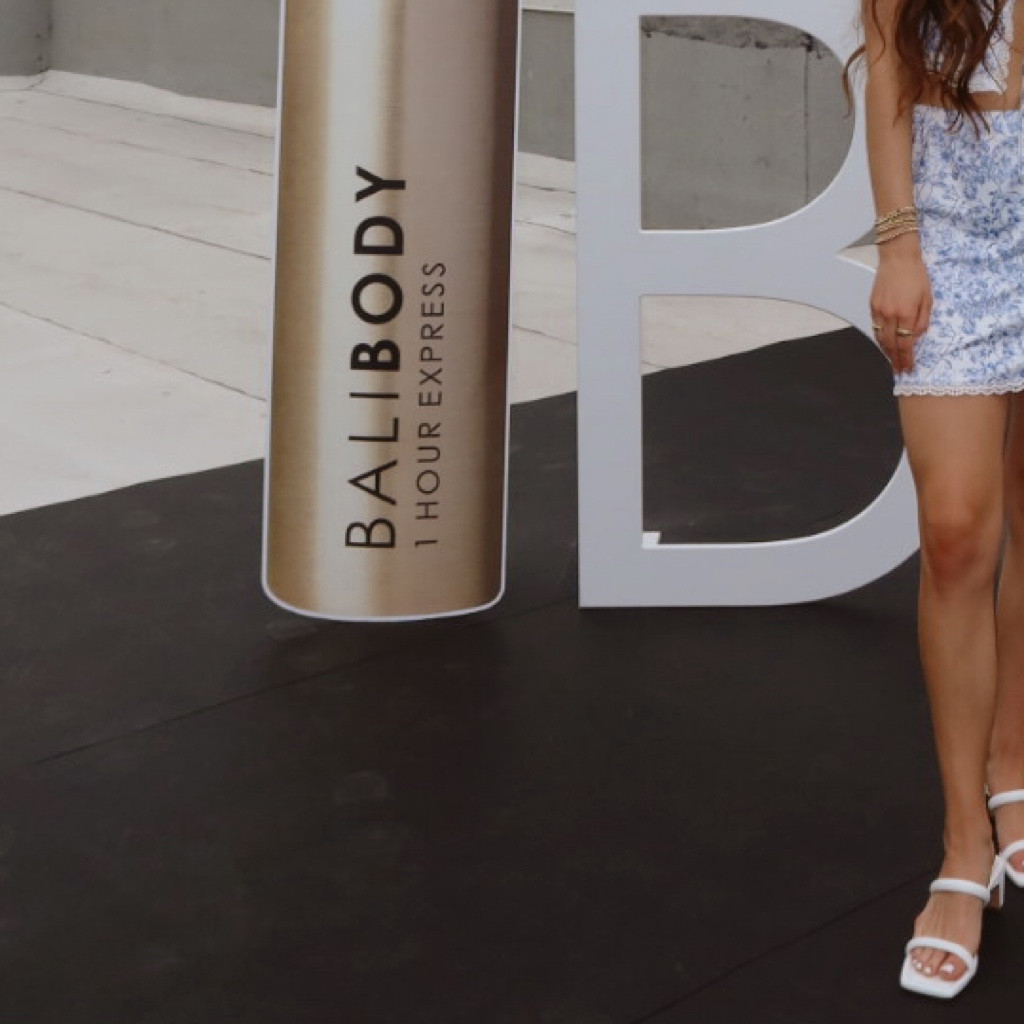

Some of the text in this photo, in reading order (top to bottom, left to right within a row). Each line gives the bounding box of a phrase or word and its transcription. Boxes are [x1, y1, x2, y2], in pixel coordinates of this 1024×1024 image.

[345, 165, 406, 549] BALIBODY
[414, 262, 447, 549] 1 HOUR EXPRESS
